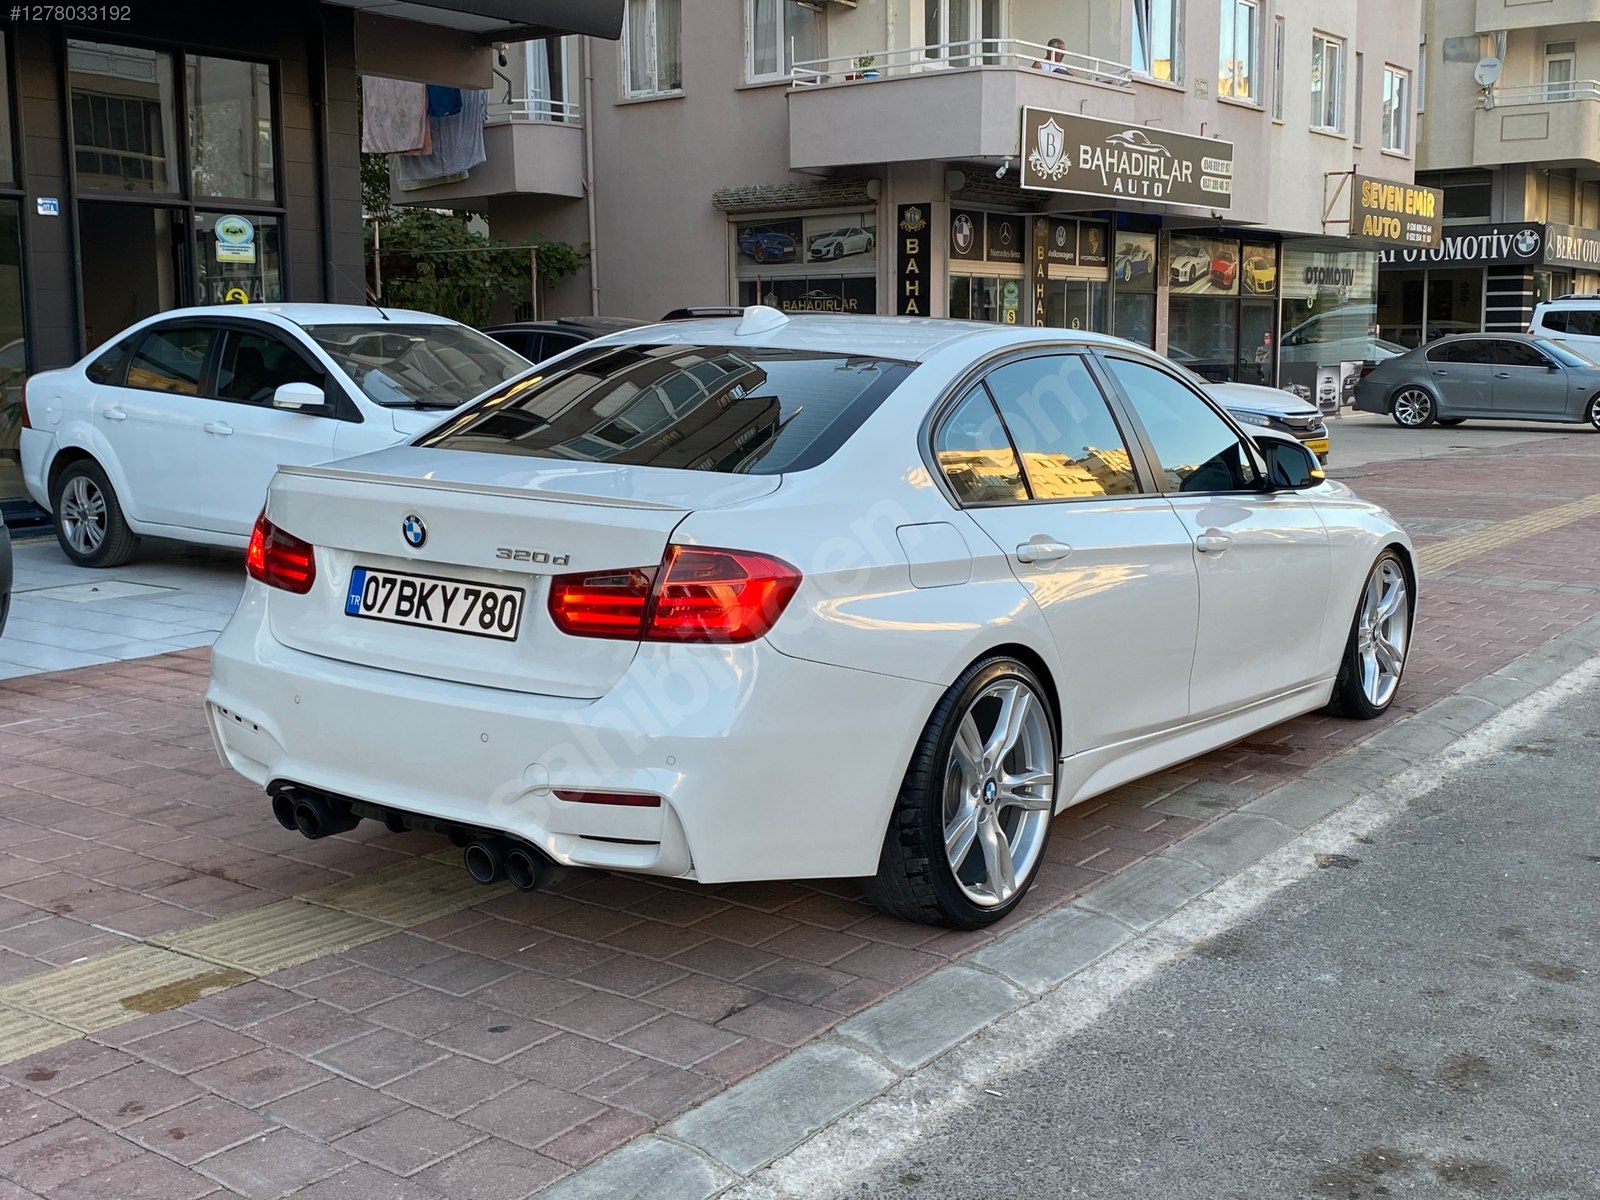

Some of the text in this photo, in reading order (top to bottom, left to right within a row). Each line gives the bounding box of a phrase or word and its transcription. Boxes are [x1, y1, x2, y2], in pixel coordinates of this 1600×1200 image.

[1079, 144, 1193, 193] BAHADIRLAR
[1113, 177, 1163, 197] AUTO
[1361, 180, 1404, 213] SEVEN
[1362, 214, 1401, 239] AUTO
[1556, 235, 1600, 263] BERAT OTO
[496, 547, 571, 566] 320d
[350, 594, 361, 606] TR
[362, 575, 516, 632] 07BKY780
